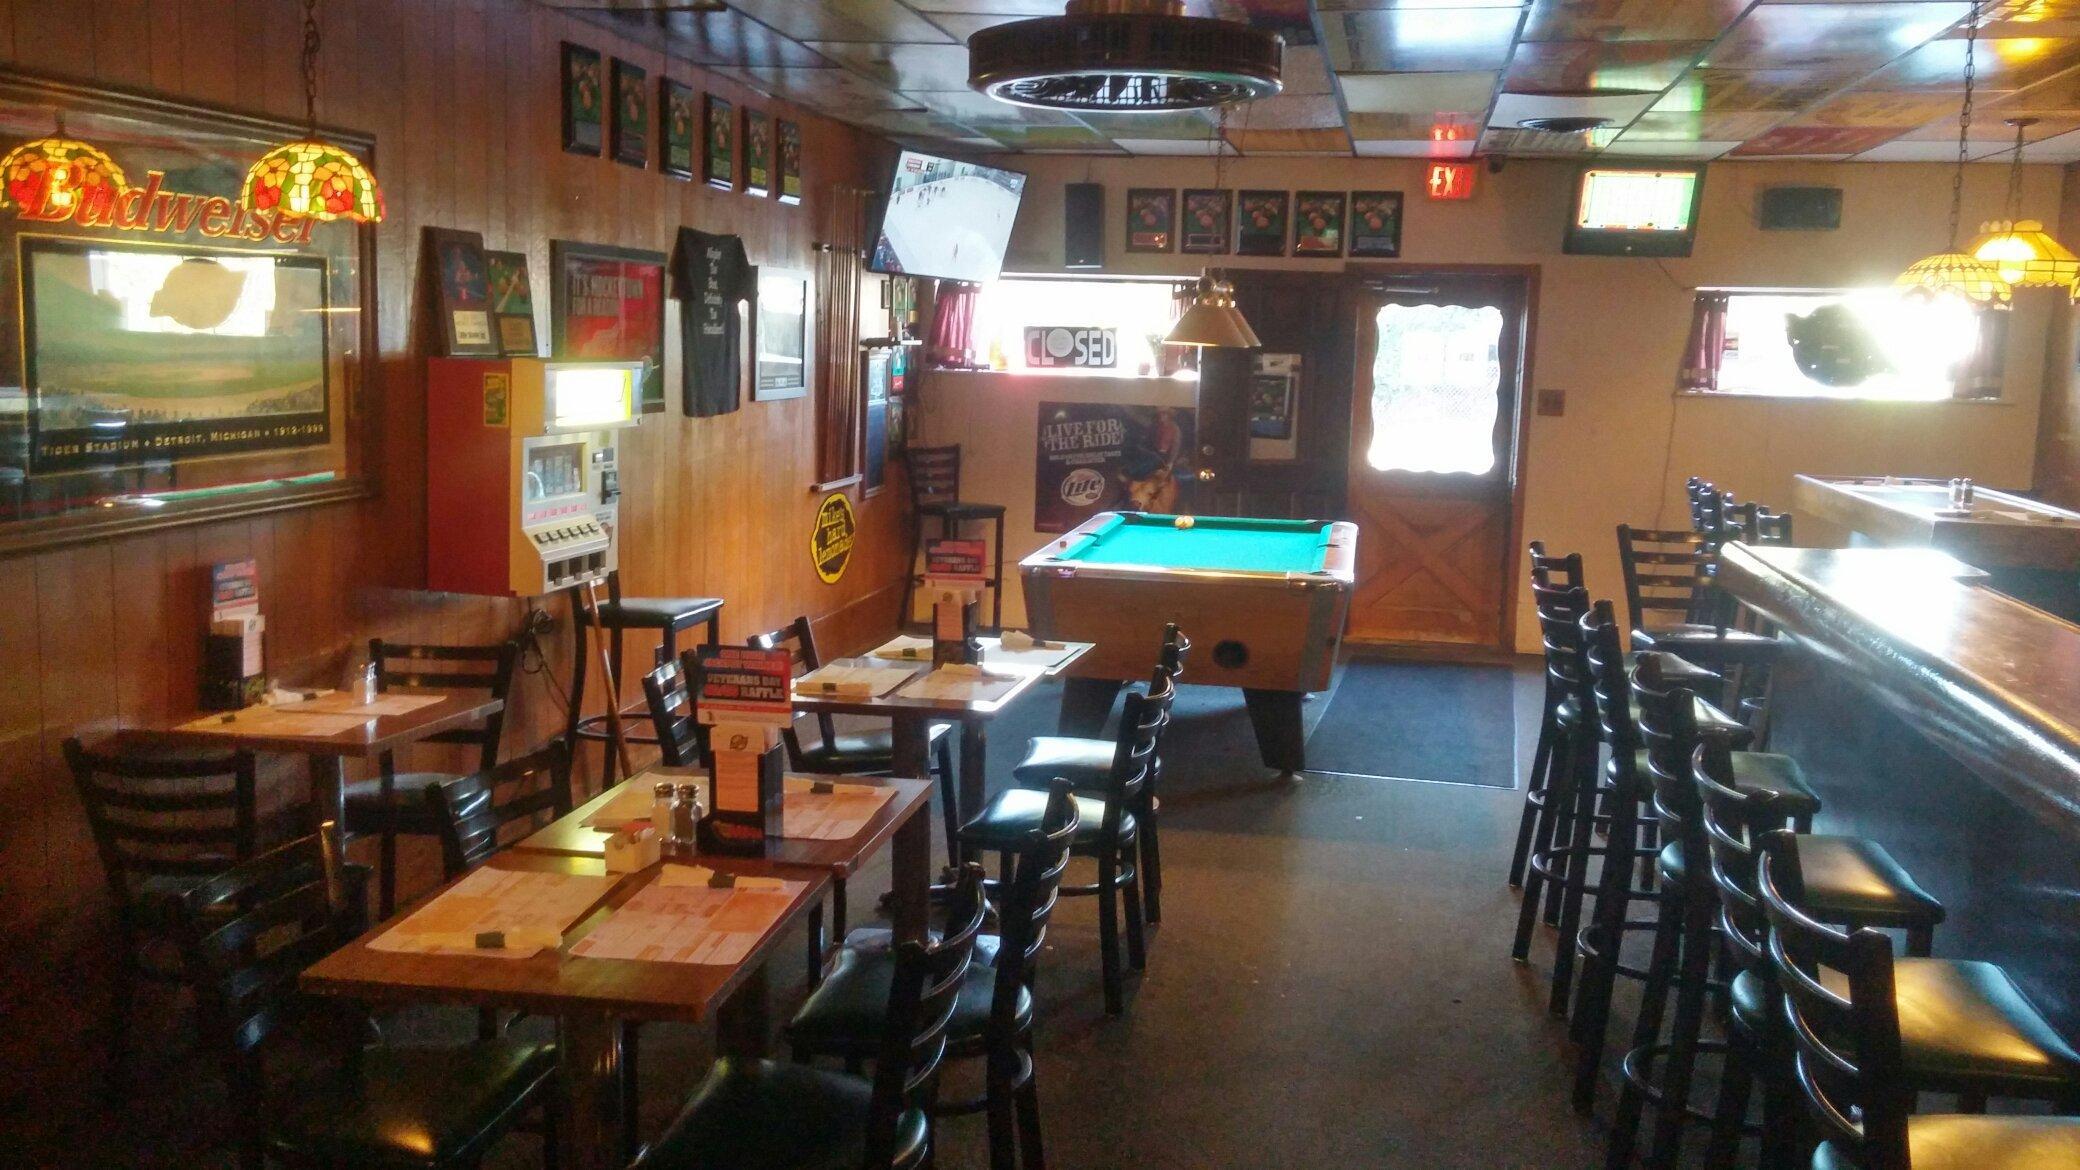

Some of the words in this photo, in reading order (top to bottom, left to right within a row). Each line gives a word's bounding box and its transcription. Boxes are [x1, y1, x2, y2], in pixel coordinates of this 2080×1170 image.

[16, 159, 317, 245] Budweiser
[1027, 328, 1115, 366] CLOSED
[210, 429, 261, 443] MICHIGAN
[1047, 422, 1084, 438] LIVE
[1086, 418, 1120, 434] FOR
[1048, 436, 1080, 451] THE
[1082, 432, 1121, 449] RIDE
[707, 673, 761, 686] VETERANS
[740, 686, 785, 699] RAFFLE
